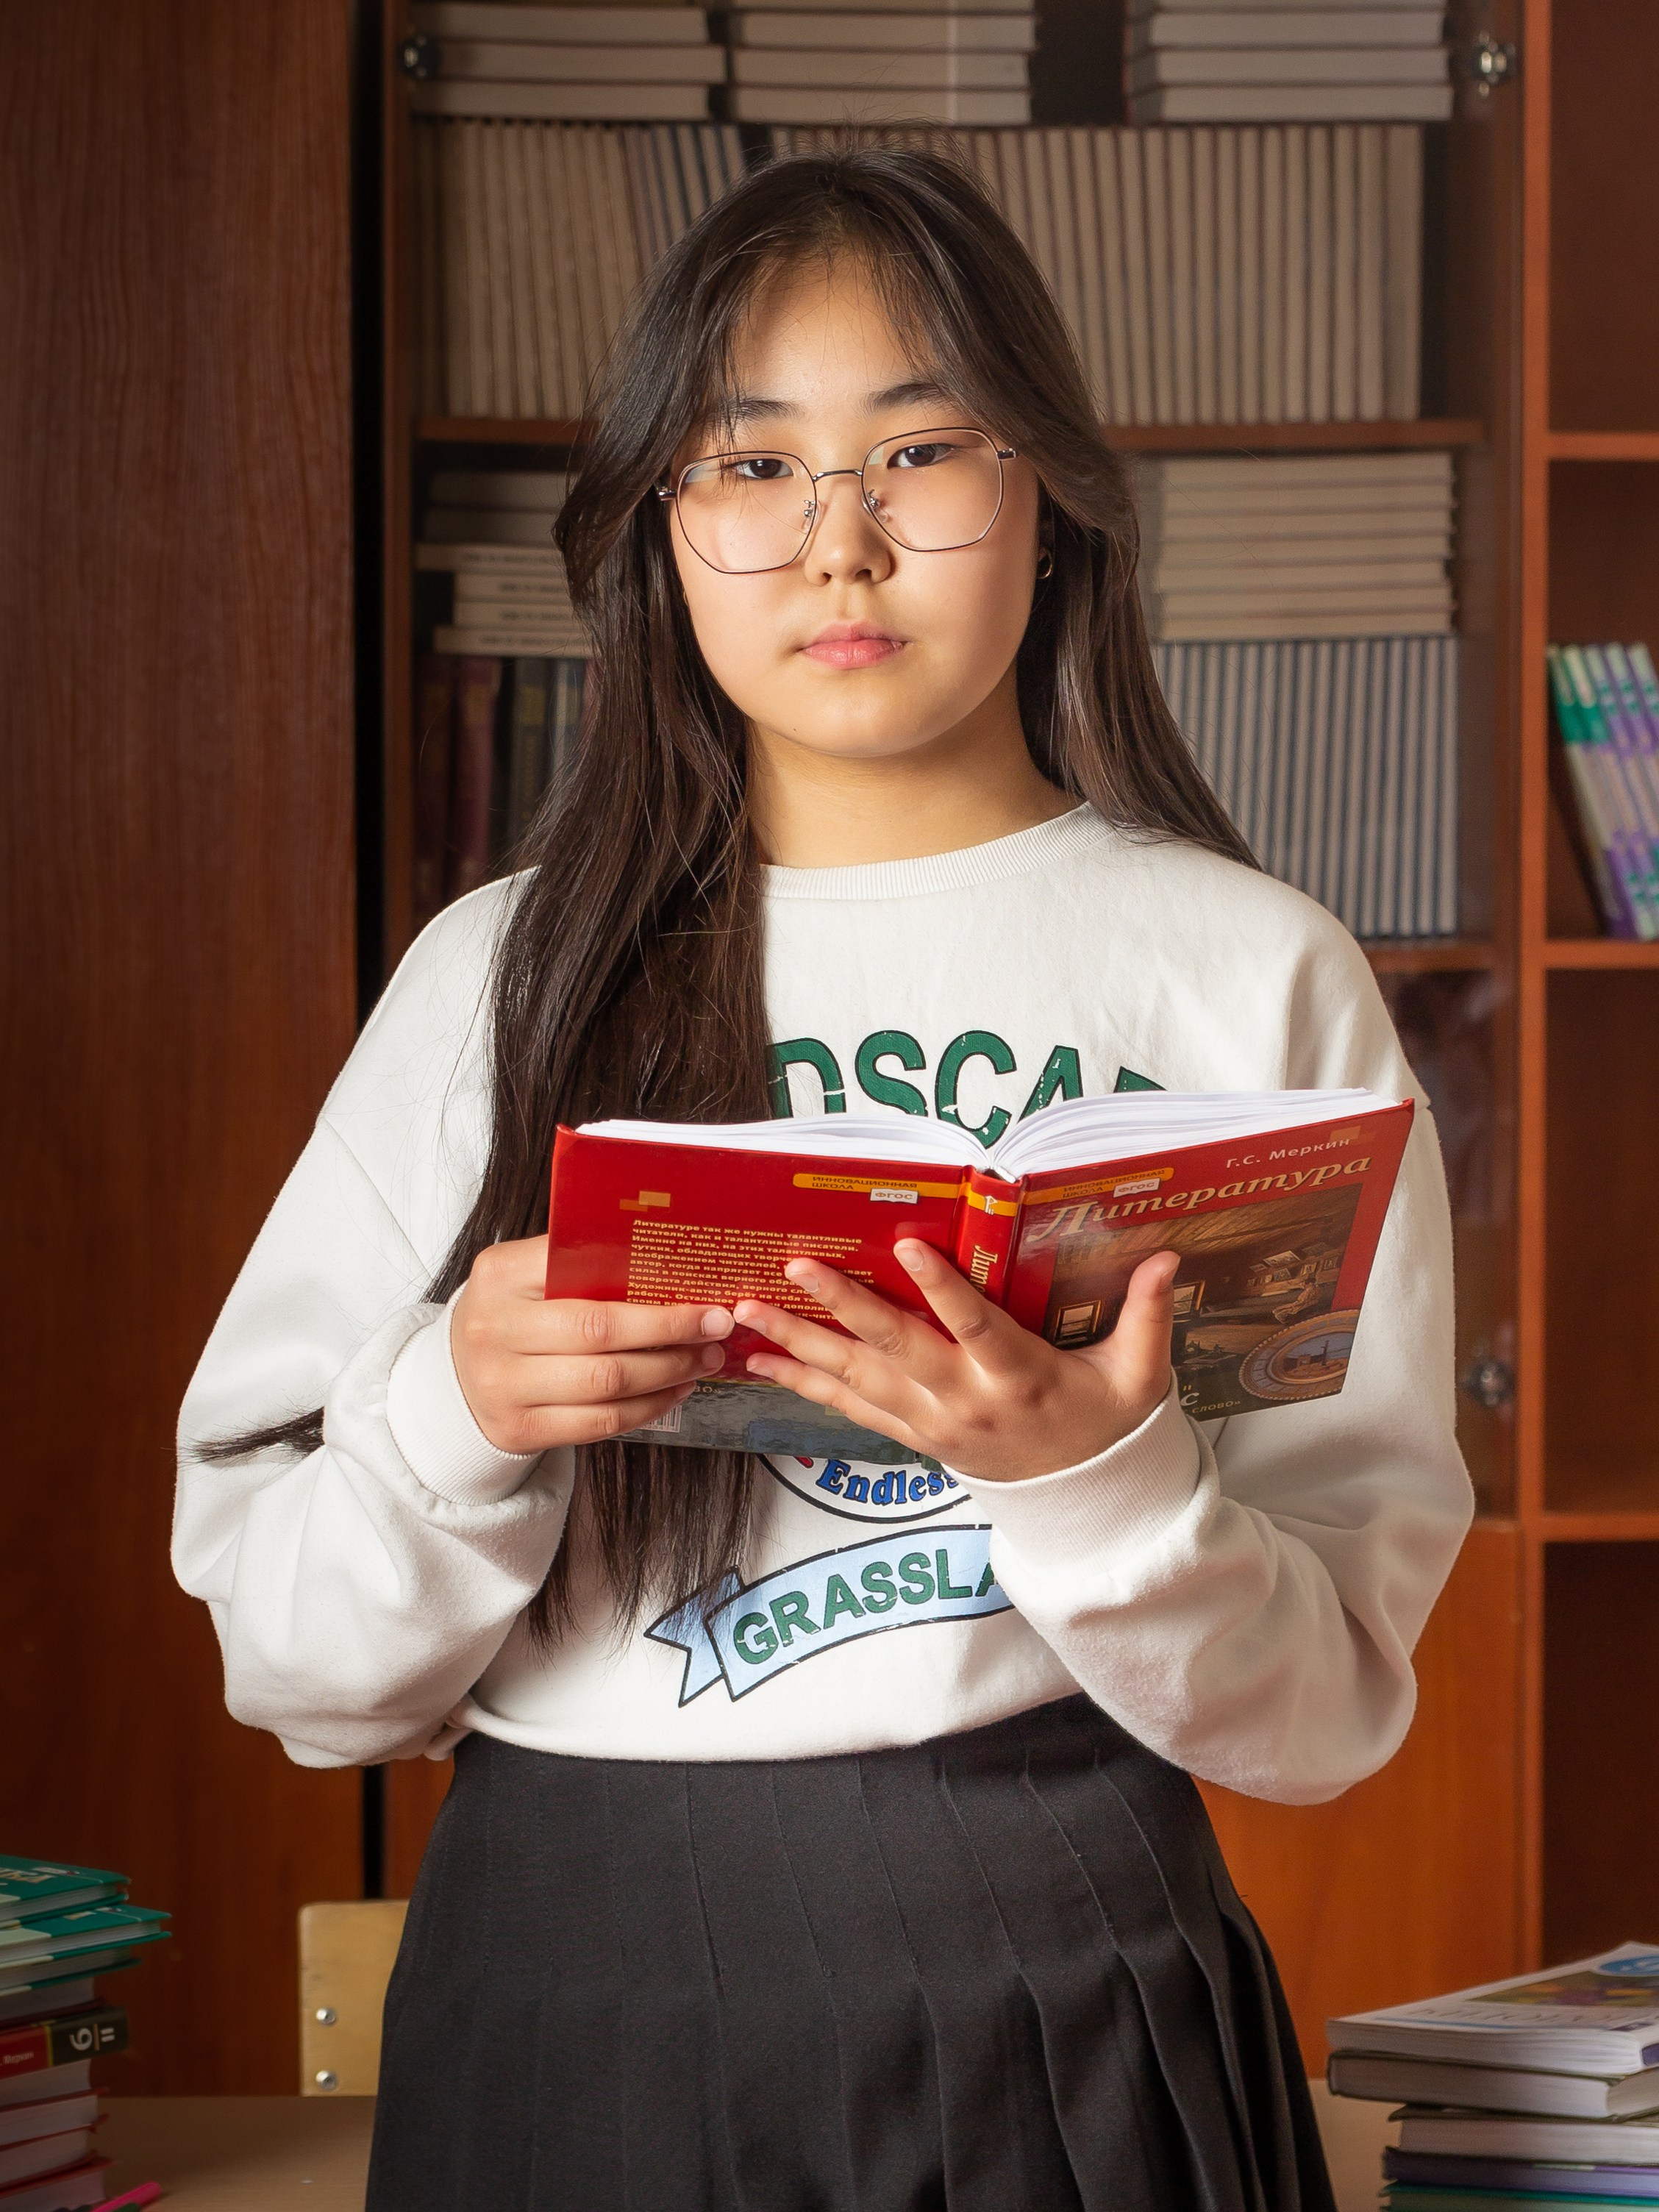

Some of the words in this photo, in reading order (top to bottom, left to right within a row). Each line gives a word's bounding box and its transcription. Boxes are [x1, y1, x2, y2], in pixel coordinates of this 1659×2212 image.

[767, 1030, 1166, 1149] DSCA
[1226, 1155, 1260, 1169] Г.С.
[1269, 1138, 1350, 1160] Меркин
[813, 1177, 918, 1188] ИННОВАЦИОННАЯ
[1063, 1169, 1166, 1192] ИННОВАЦИОННАЯ
[1062, 1187, 1103, 1198] ШКОЛА
[1118, 1181, 1155, 1194] ФГОС
[875, 1191, 913, 1200] ФГОС
[1027, 1157, 1371, 1242] Литература
[633, 1219, 699, 1232] Литературе
[743, 1230, 784, 1238] нужны
[787, 1233, 862, 1244] талантливые
[632, 1235, 676, 1244] Именно
[724, 1236, 799, 1247] талантливые
[631, 1252, 716, 1264] воображением
[677, 1248, 751, 1260] обладающих
[668, 1263, 701, 1271] когда
[704, 1266, 761, 1277] напрягает
[628, 1274, 680, 1284] поворота
[742, 1284, 788, 1294] верного
[671, 1271, 718, 1280] поисках
[721, 1275, 766, 1284] верного
[627, 1282, 721, 1296] Художник-автор
[724, 1288, 757, 1299] берёт
[775, 1294, 801, 1302] себя
[626, 1297, 661, 1305] своим
[675, 1294, 734, 1305] Остальное
[783, 1302, 830, 1312] дополни
[69, 2027, 93, 2051] 6
